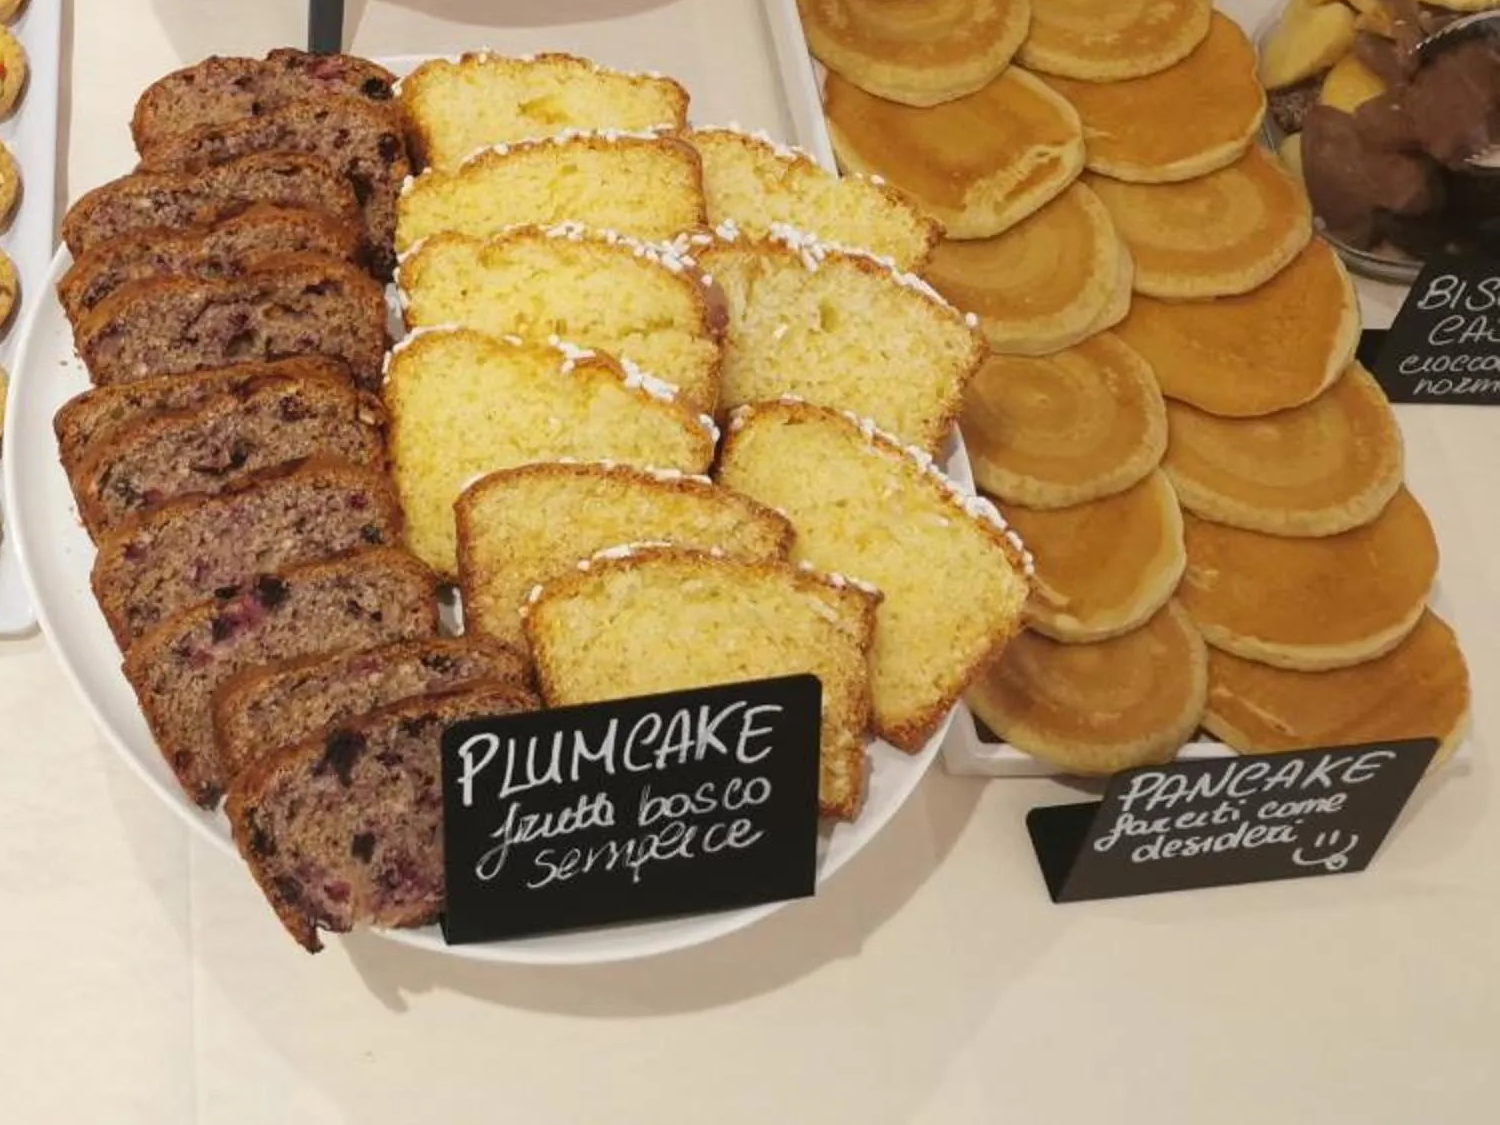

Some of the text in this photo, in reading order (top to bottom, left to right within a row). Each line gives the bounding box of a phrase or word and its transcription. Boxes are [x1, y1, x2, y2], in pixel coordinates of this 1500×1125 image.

[1416, 273, 1500, 313] BIS
[456, 700, 785, 808] PLUMCAKE
[638, 776, 772, 826] bosco
[1117, 750, 1398, 813] PANCAKE
[1257, 791, 1348, 820] come
